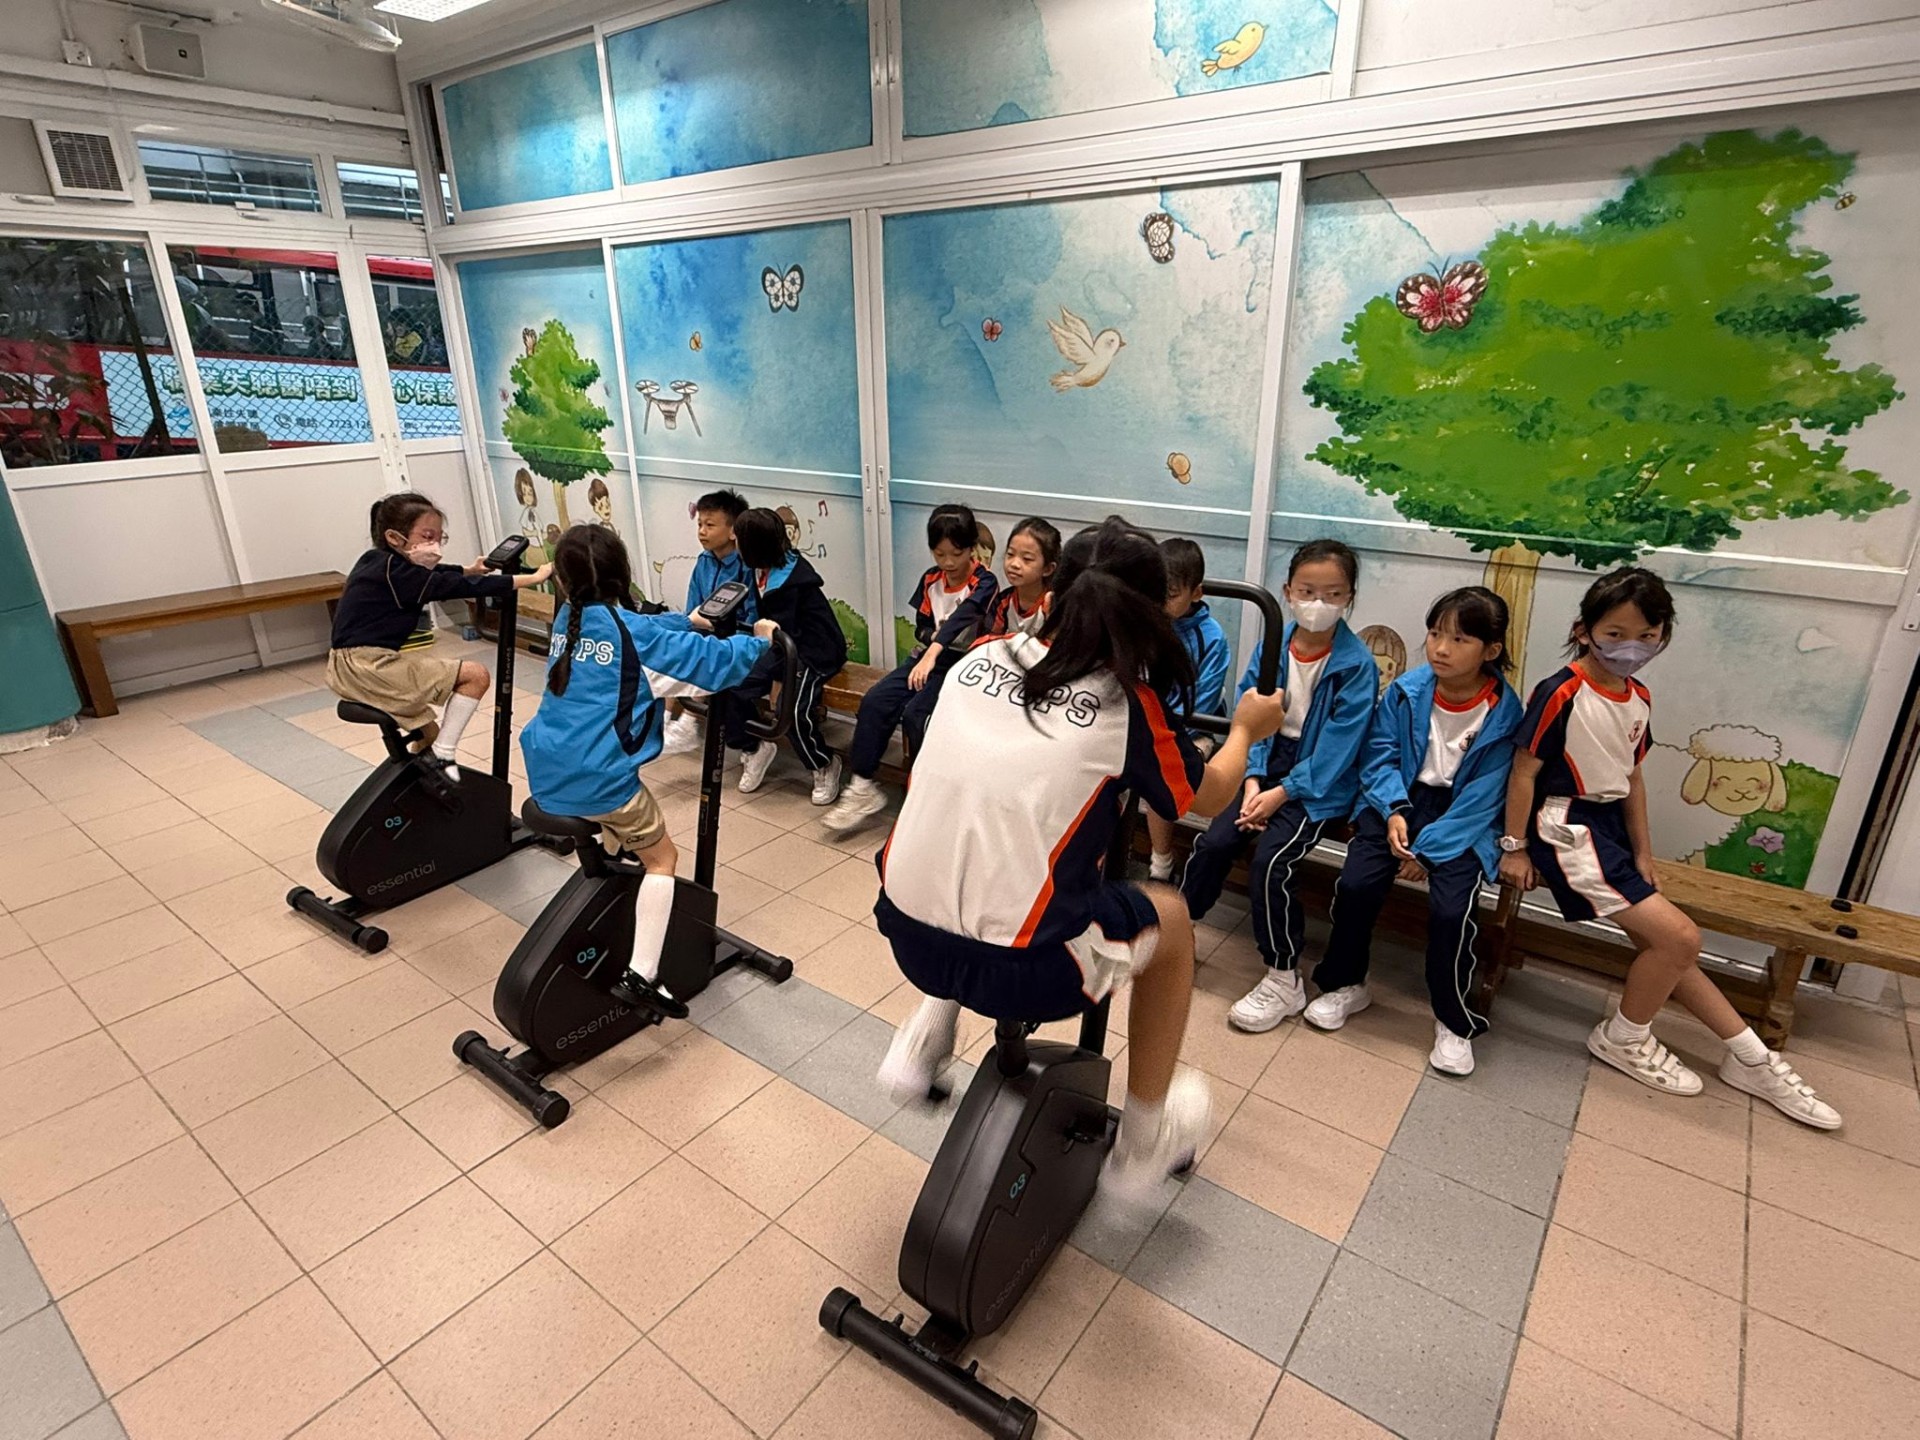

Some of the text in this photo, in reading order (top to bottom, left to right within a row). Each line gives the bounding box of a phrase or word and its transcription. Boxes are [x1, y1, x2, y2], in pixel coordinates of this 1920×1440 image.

[384, 815, 402, 829] 03
[366, 859, 436, 896] essential
[576, 946, 597, 965] 03
[1009, 1173, 1026, 1199] 03
